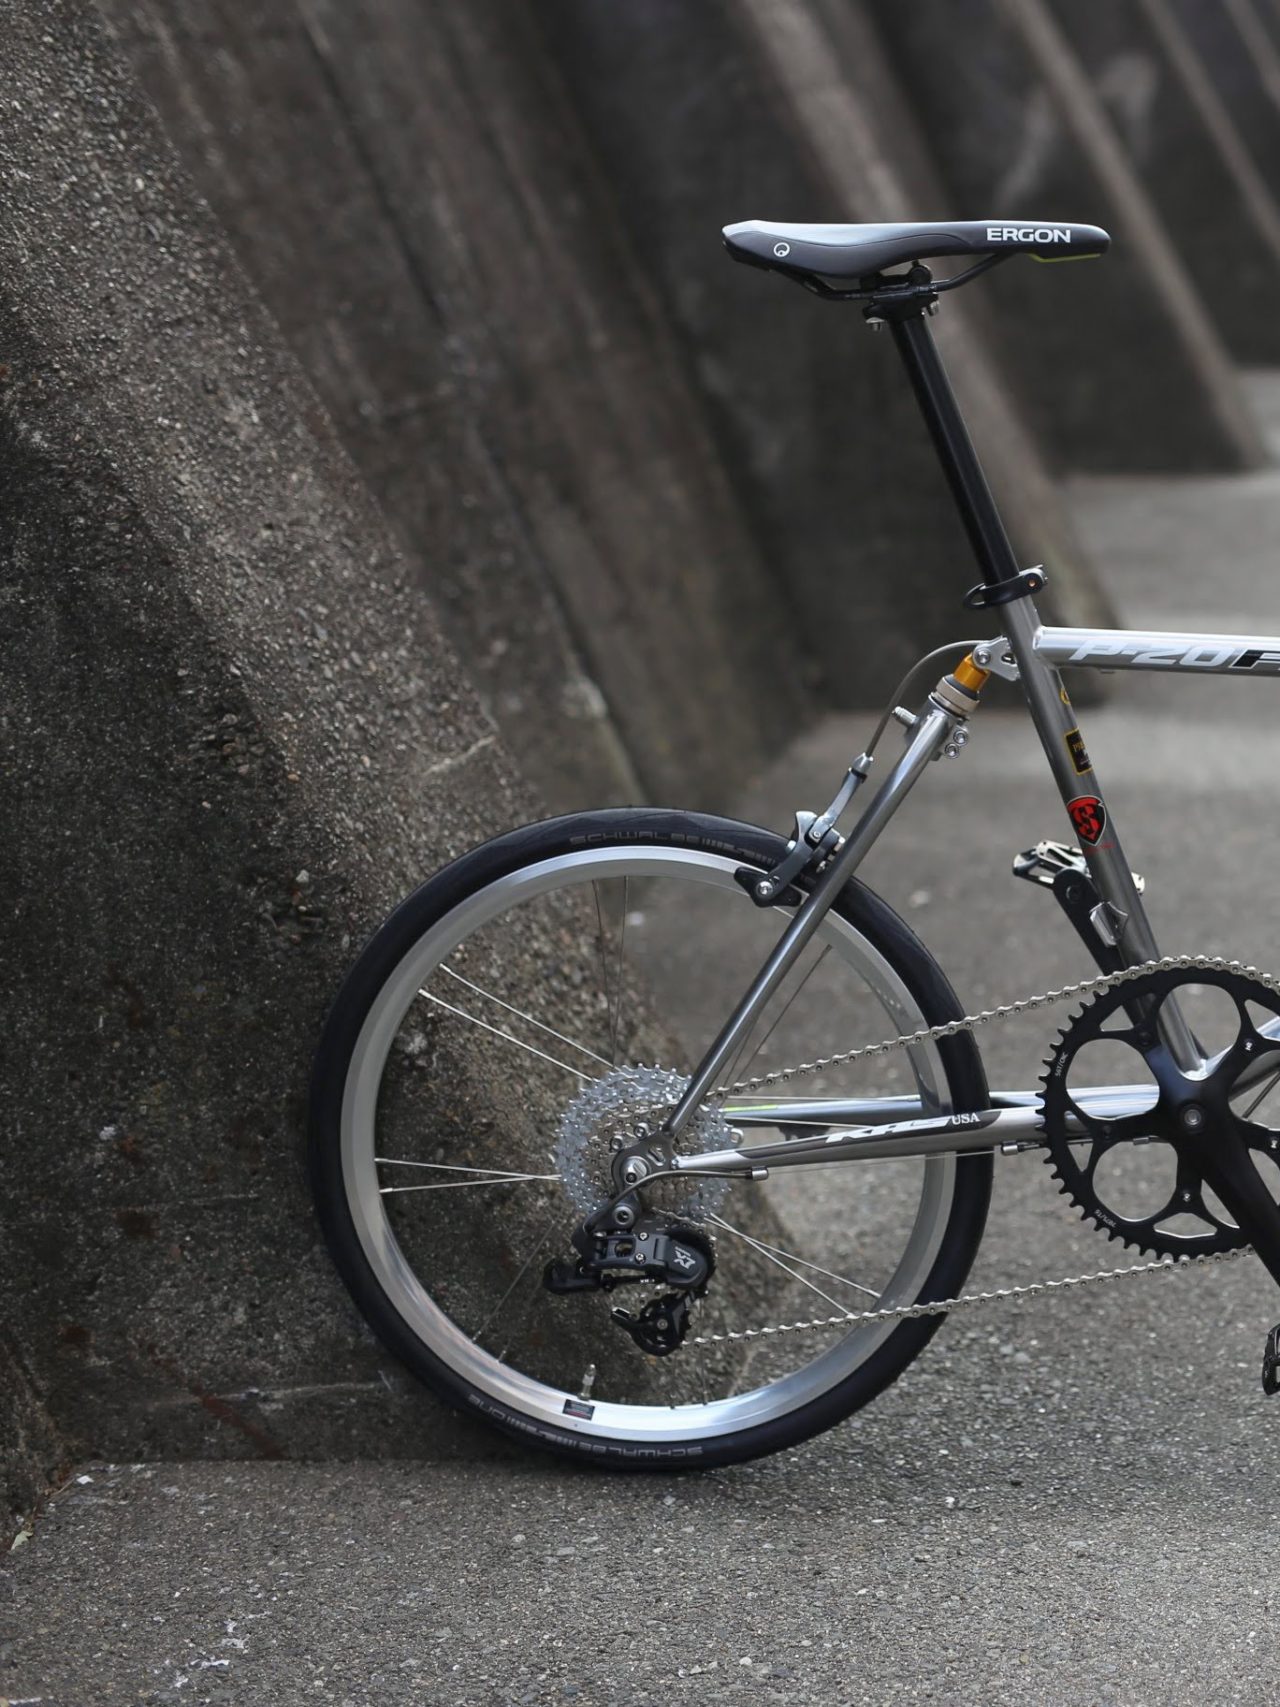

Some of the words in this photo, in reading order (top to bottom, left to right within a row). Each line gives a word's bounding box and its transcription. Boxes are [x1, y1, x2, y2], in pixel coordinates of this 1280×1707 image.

[986, 227, 1072, 244] ERGON
[569, 831, 697, 845] SCHWALBE
[951, 1112, 981, 1125] USA
[469, 1394, 505, 1420] ONE
[580, 1441, 703, 1457] SCHWALBE
